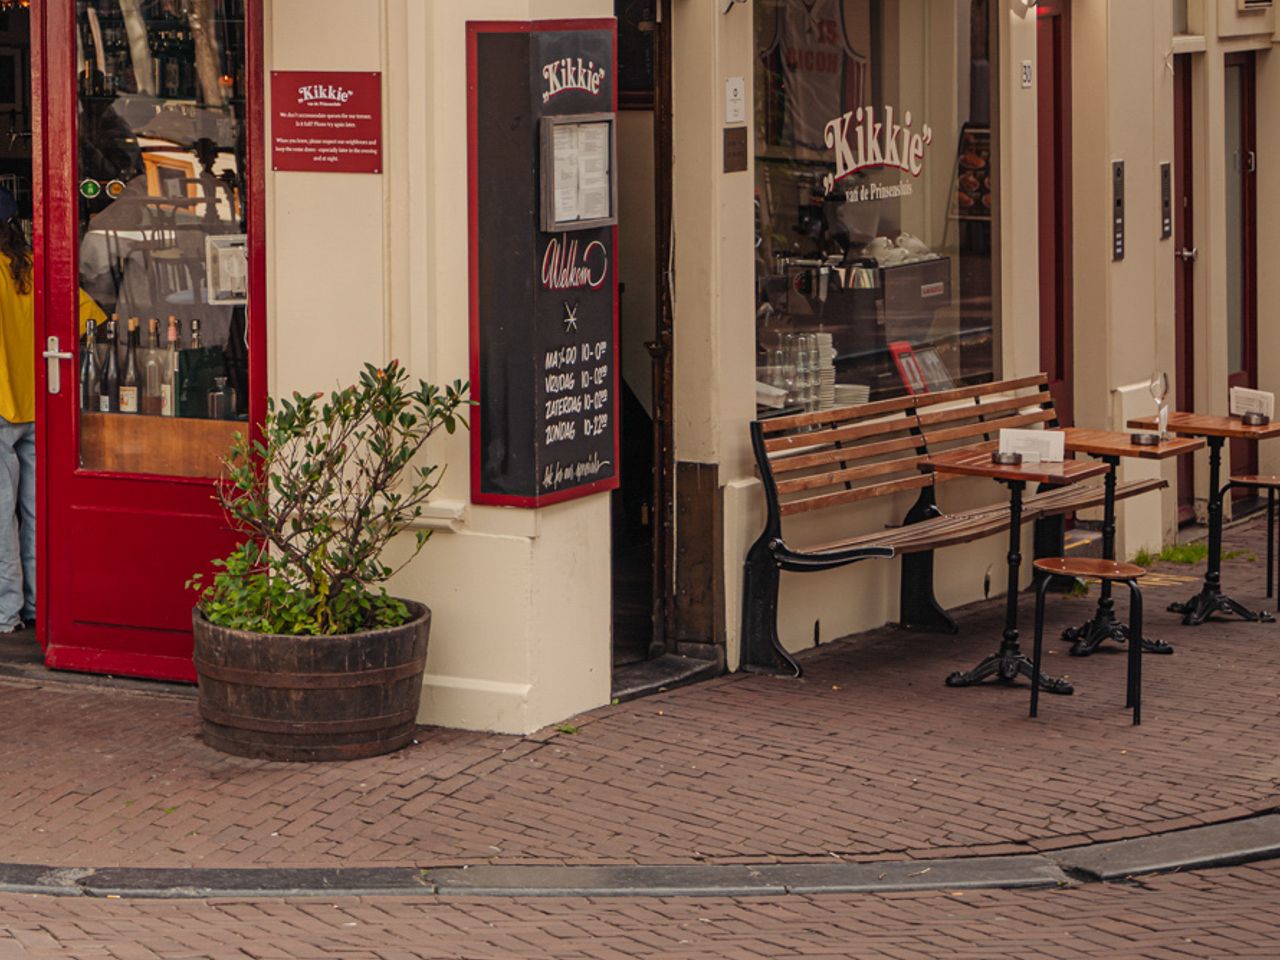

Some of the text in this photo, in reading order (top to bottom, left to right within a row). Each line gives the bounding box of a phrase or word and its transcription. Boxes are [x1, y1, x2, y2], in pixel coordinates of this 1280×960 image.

[845, 187, 859, 202] van
[860, 185, 869, 201] de
[542, 232, 608, 289] Welkom
[545, 395, 582, 420] ZATERDAG
[545, 421, 575, 445] ZONDAG
